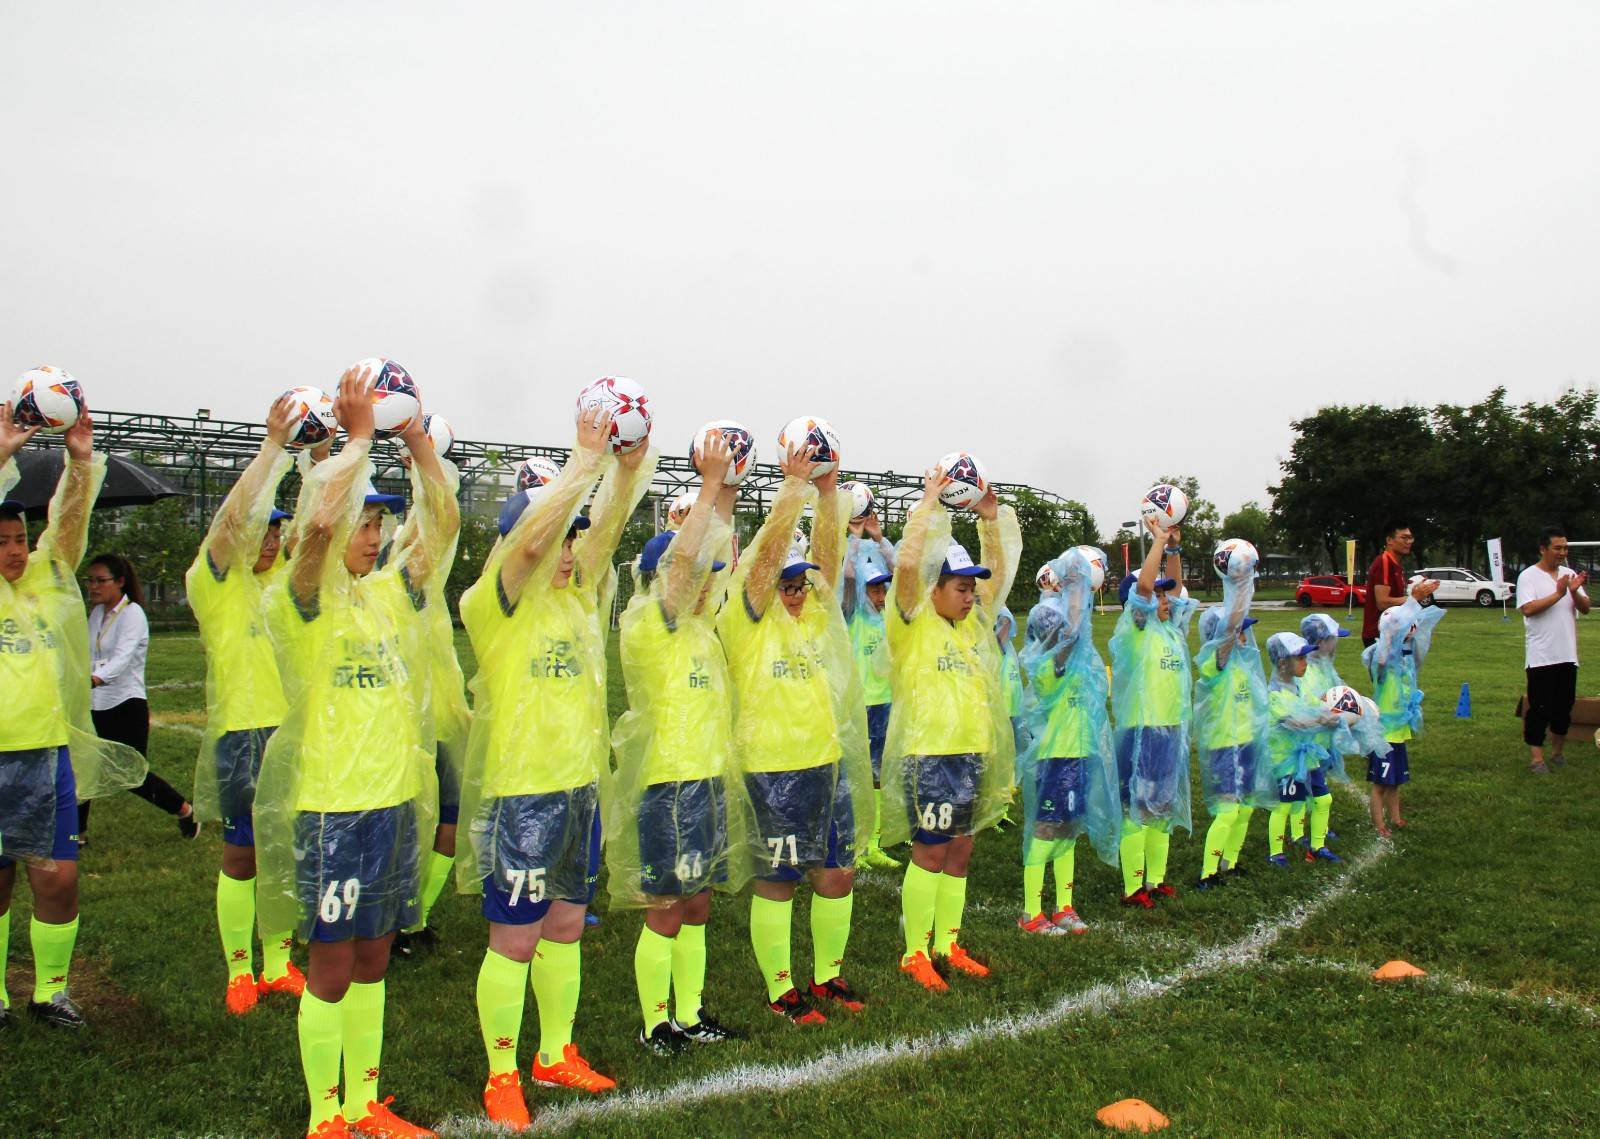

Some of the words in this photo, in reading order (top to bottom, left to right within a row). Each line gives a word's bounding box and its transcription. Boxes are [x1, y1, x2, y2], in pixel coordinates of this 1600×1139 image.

[1381, 762, 1391, 778] 7
[1068, 789, 1075, 812] 8
[1282, 778, 1297, 796] 16
[922, 802, 953, 831] 68
[767, 835, 798, 868] 71
[675, 852, 702, 881] 66
[320, 878, 360, 923] 69
[507, 868, 546, 907] 75
